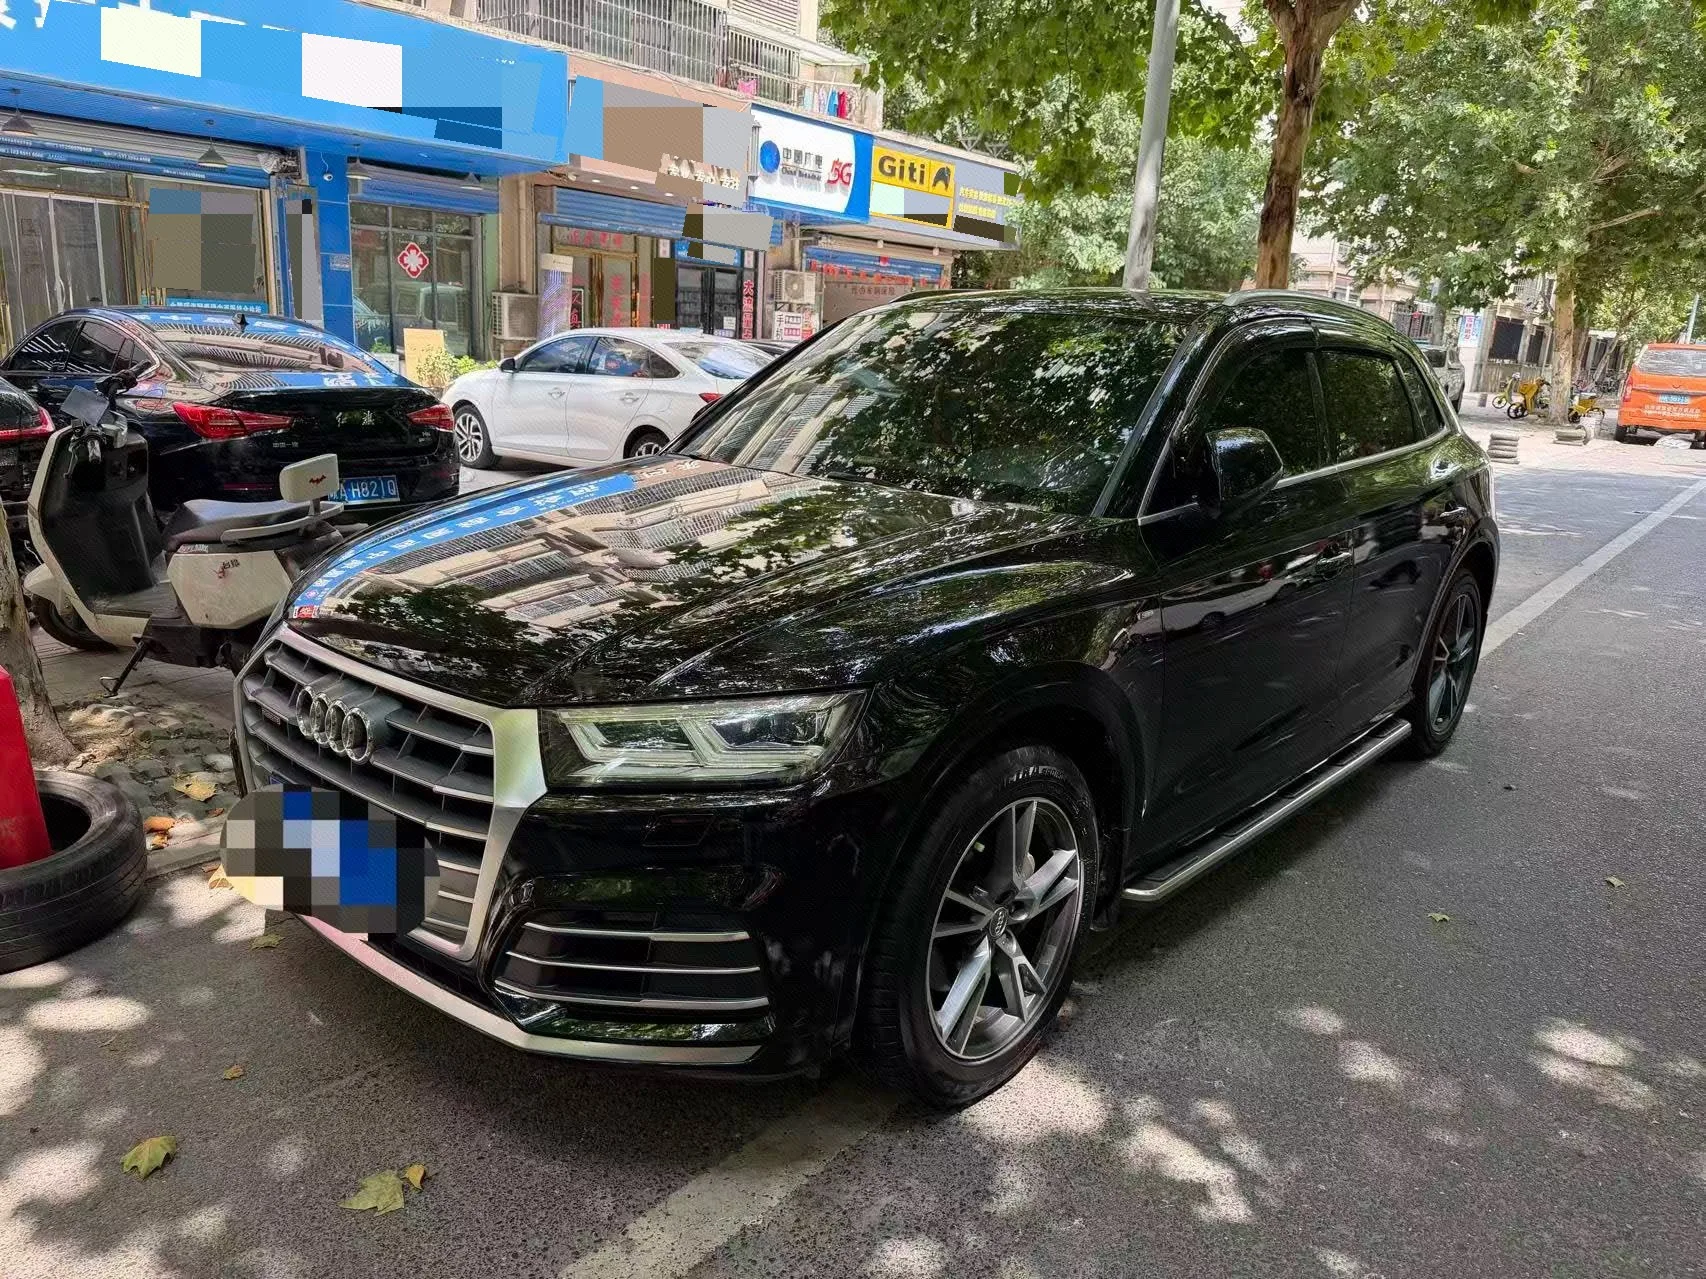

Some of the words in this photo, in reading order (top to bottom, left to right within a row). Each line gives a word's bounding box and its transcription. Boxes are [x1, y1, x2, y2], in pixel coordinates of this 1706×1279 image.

[783, 147, 823, 169] 中国广电
[827, 158, 853, 186] 5G
[878, 155, 926, 185] Giti
